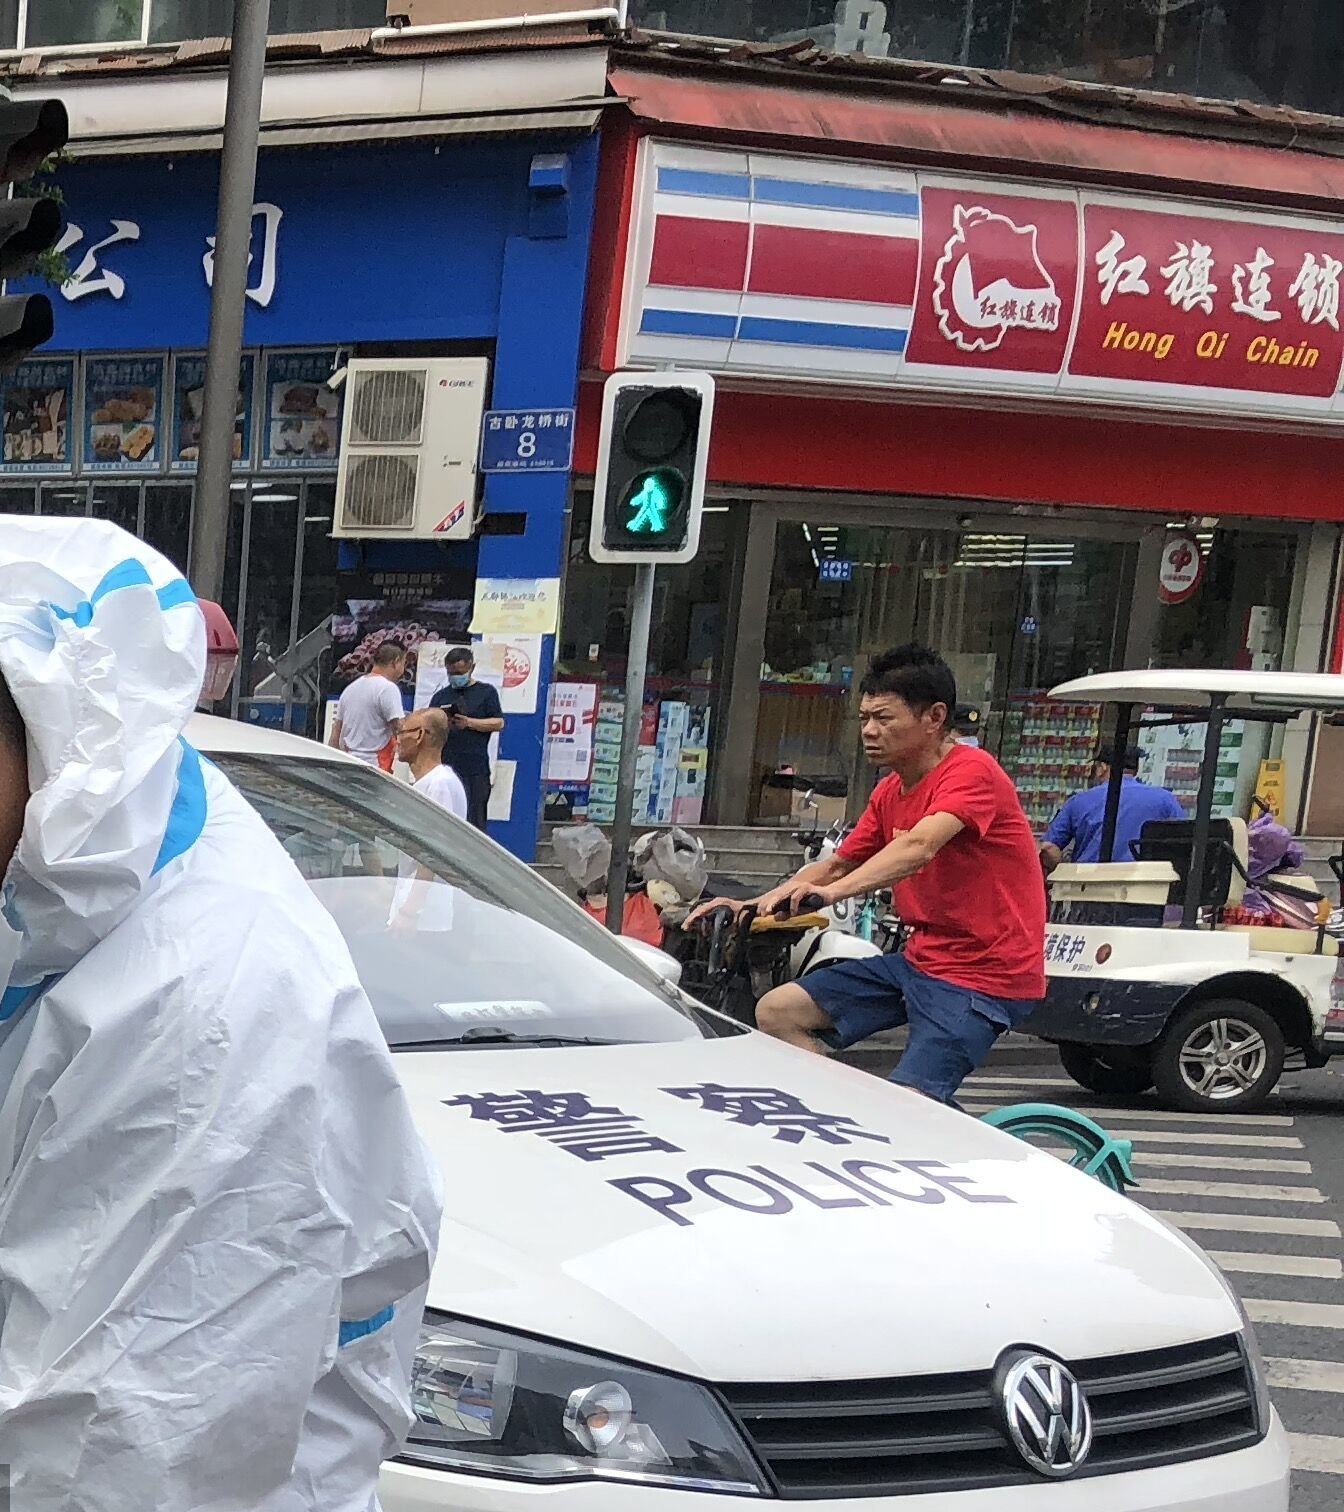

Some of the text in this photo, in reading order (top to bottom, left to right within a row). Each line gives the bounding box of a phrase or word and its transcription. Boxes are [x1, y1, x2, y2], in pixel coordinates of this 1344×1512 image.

[1095, 229, 1344, 332] 红旗连锁
[979, 295, 1058, 326] 红旗连锁
[1102, 321, 1321, 369] Hong Qi Chain
[517, 431, 537, 458] 8
[439, 1082, 892, 1162] 警察
[604, 1159, 1018, 1227] POLICE
